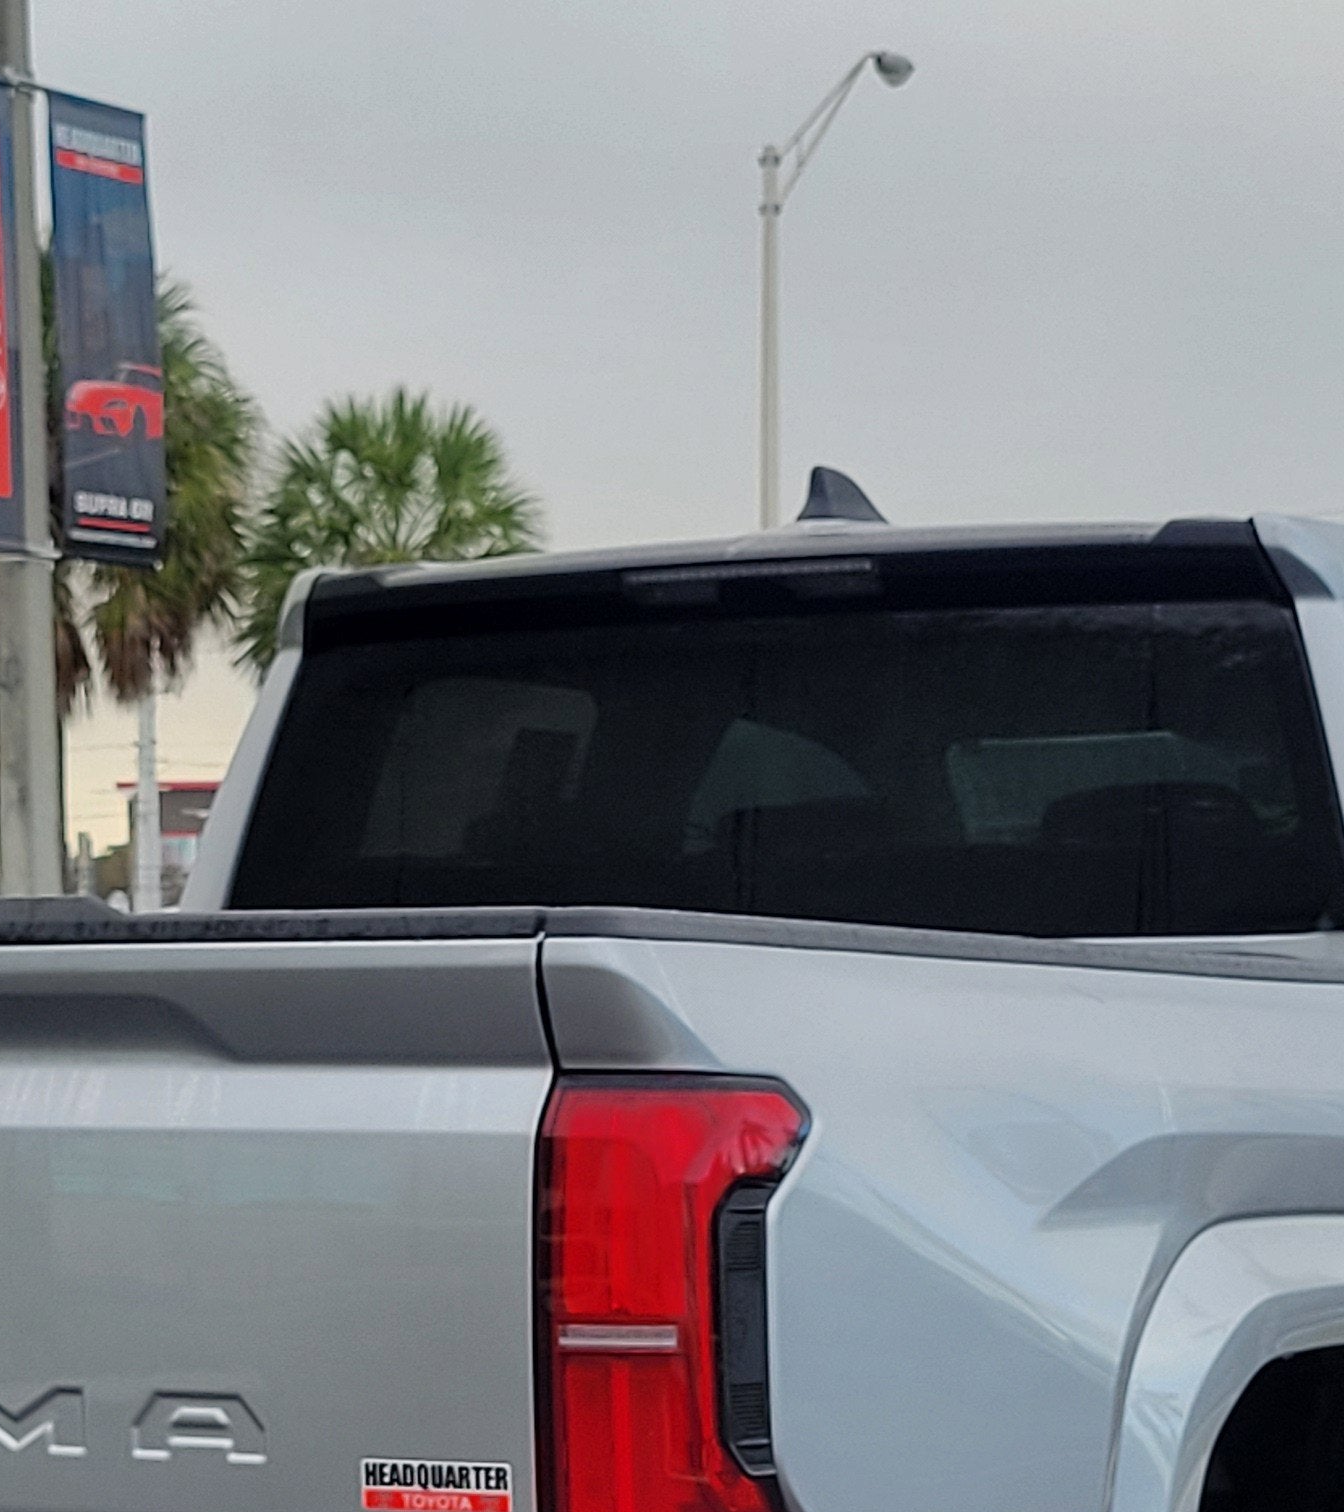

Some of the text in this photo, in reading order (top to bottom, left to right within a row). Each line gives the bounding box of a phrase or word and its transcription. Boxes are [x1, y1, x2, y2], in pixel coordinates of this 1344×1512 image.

[73, 490, 126, 518] SUPRA
[364, 1462, 509, 1491] HEADQUARTER
[402, 1493, 473, 1512] TOYOTA
